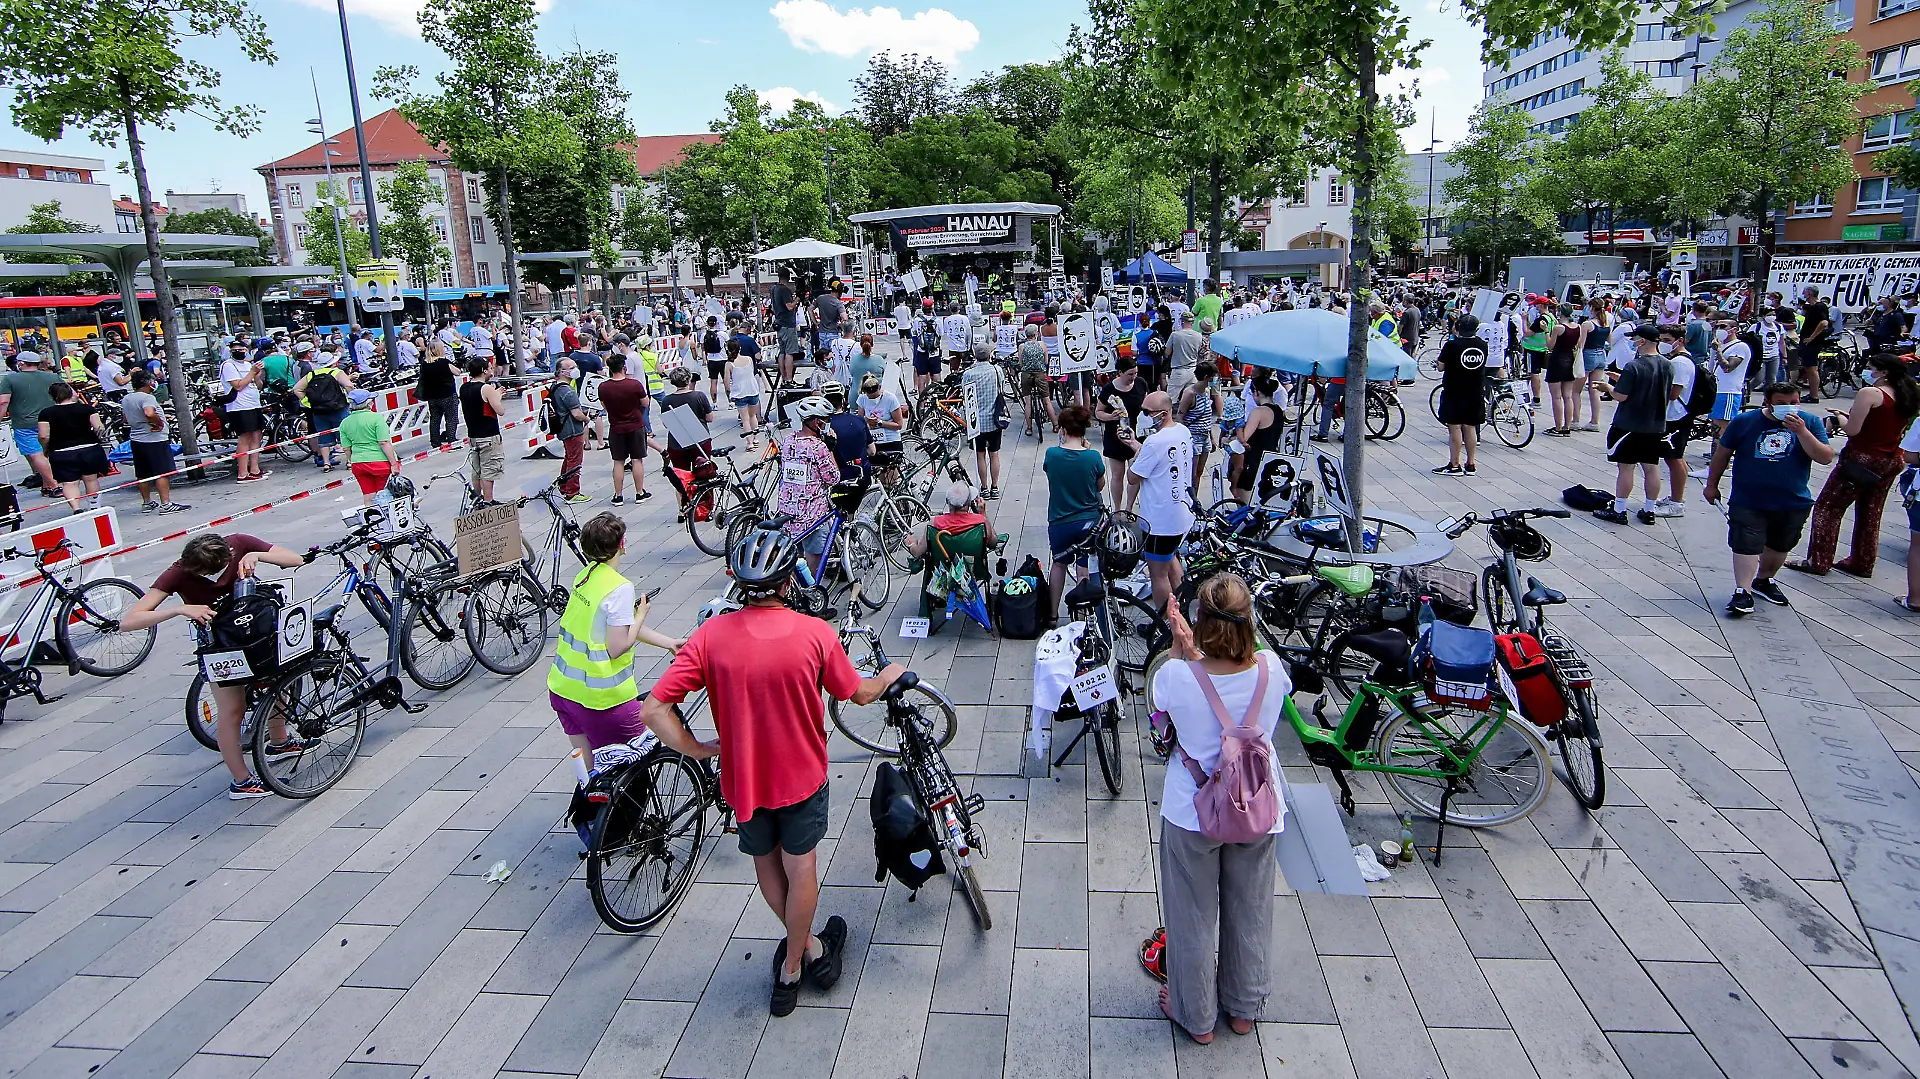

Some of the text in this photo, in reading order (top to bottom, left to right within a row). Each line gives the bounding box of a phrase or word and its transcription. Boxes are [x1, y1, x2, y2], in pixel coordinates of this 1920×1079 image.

[947, 215, 1012, 231] HANAU
[1771, 259, 1827, 270] ZUSAMMEN
[1829, 257, 1881, 270] TRAUERN,
[1778, 273, 1790, 283] ES
[1792, 272, 1808, 283] IST
[1808, 272, 1836, 284] ZEIT
[1463, 355, 1482, 363] KON
[456, 509, 494, 534] RASSISMUS
[1075, 682, 1085, 690] 19
[1096, 672, 1107, 681] 20
[1777, 674, 1841, 729] nach
